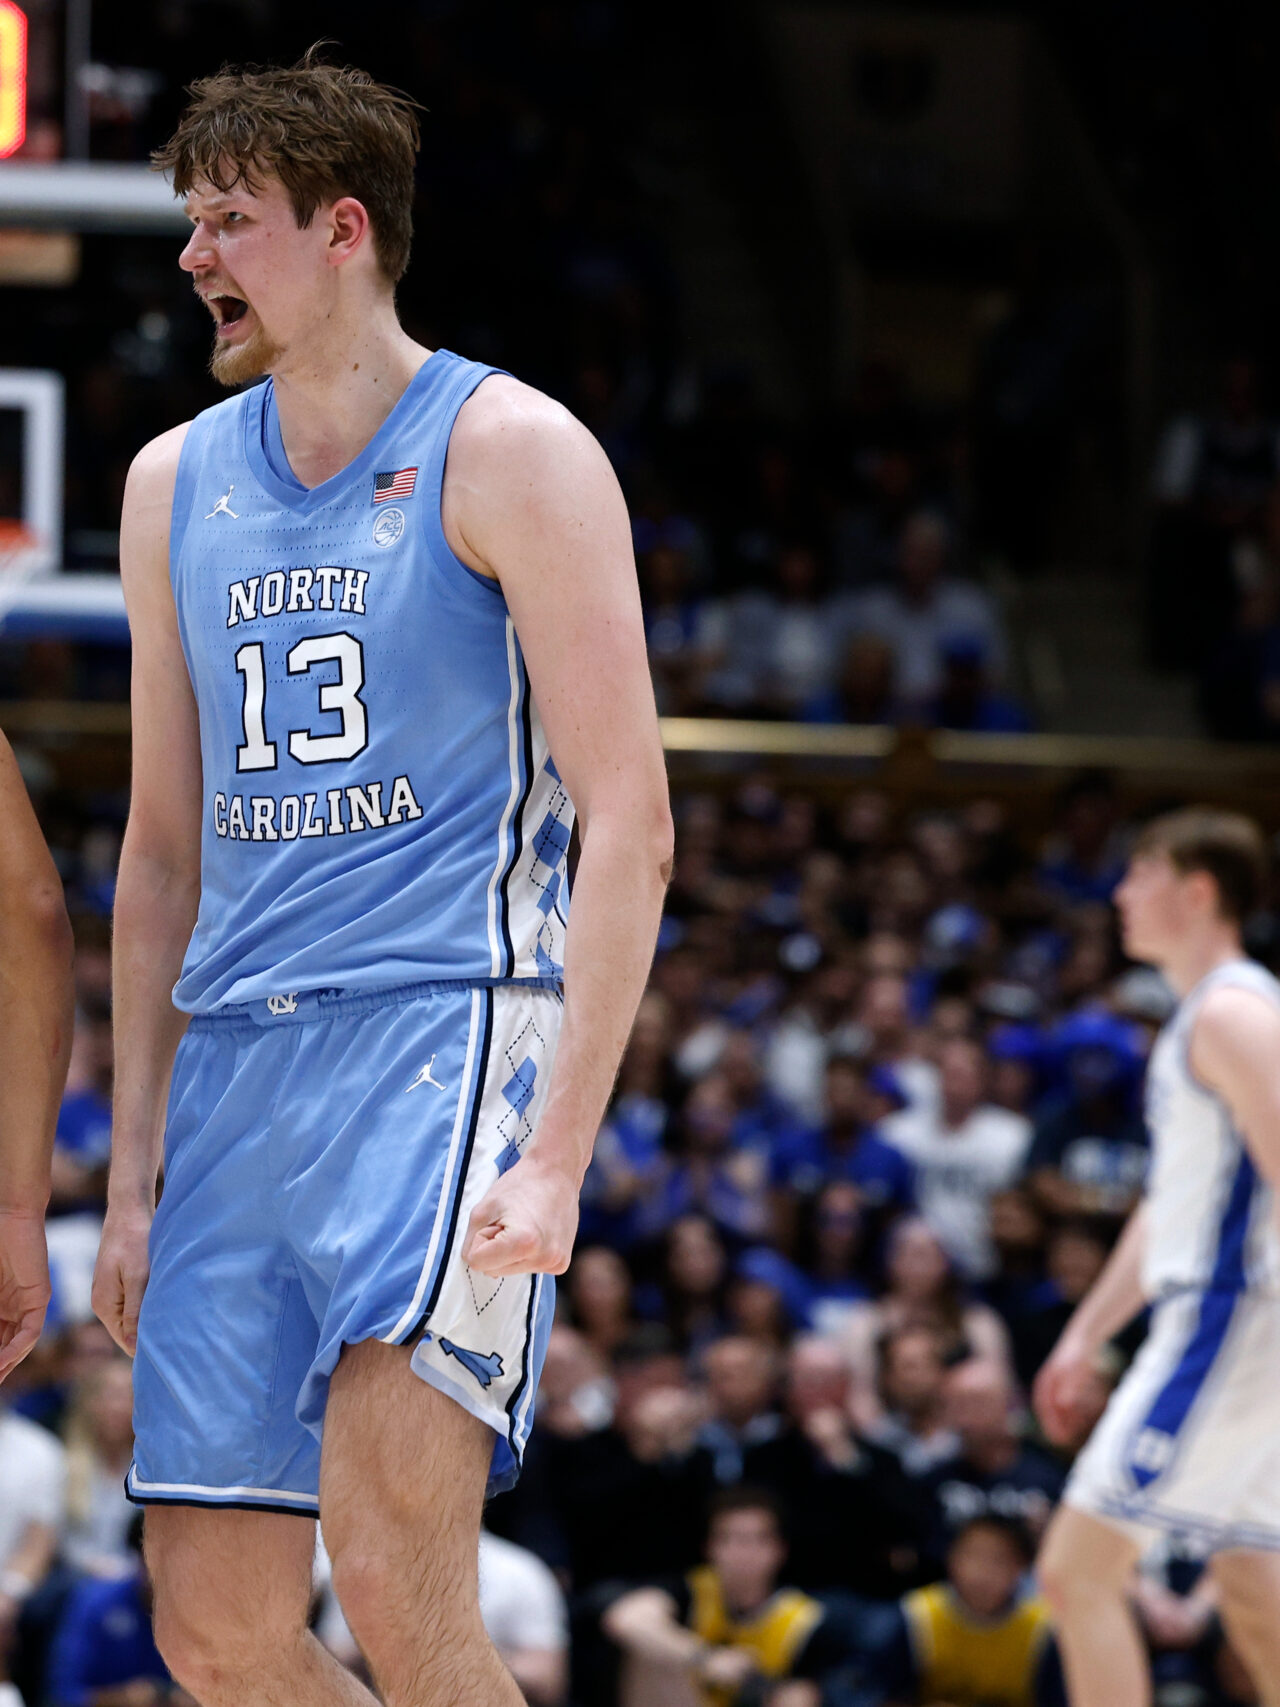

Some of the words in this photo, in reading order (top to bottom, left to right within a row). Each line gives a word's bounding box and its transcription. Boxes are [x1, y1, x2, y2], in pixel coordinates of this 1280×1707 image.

[227, 565, 370, 629] NORTH
[234, 631, 369, 774] 13
[213, 774, 424, 842] CAROLINA
